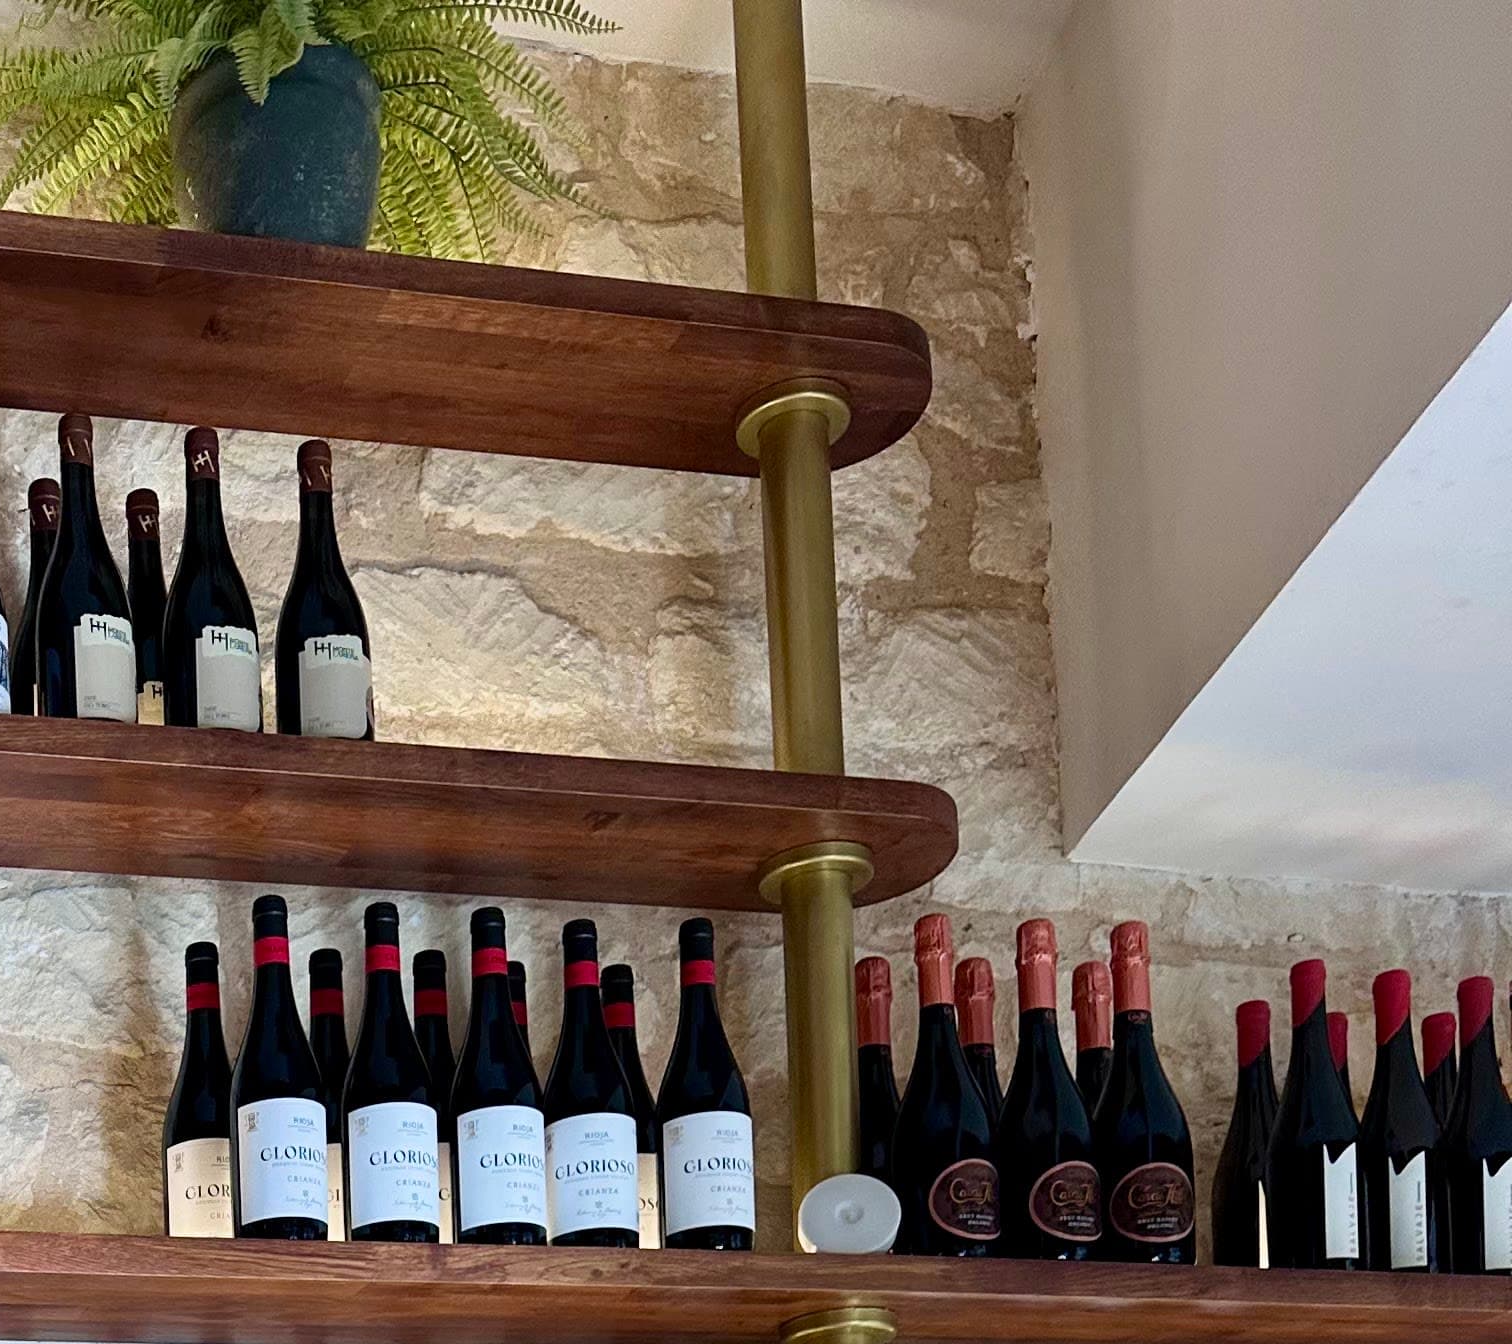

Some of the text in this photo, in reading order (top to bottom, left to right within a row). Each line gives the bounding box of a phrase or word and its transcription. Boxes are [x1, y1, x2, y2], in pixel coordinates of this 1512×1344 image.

[402, 1120, 425, 1130] RIOJA
[512, 1123, 534, 1133] RIOJA
[584, 1130, 610, 1140] RIOJA
[555, 1157, 635, 1181] GLORIOSO
[578, 1186, 619, 1197] CRIANZA
[1415, 1204, 1424, 1262] SALVAJE
